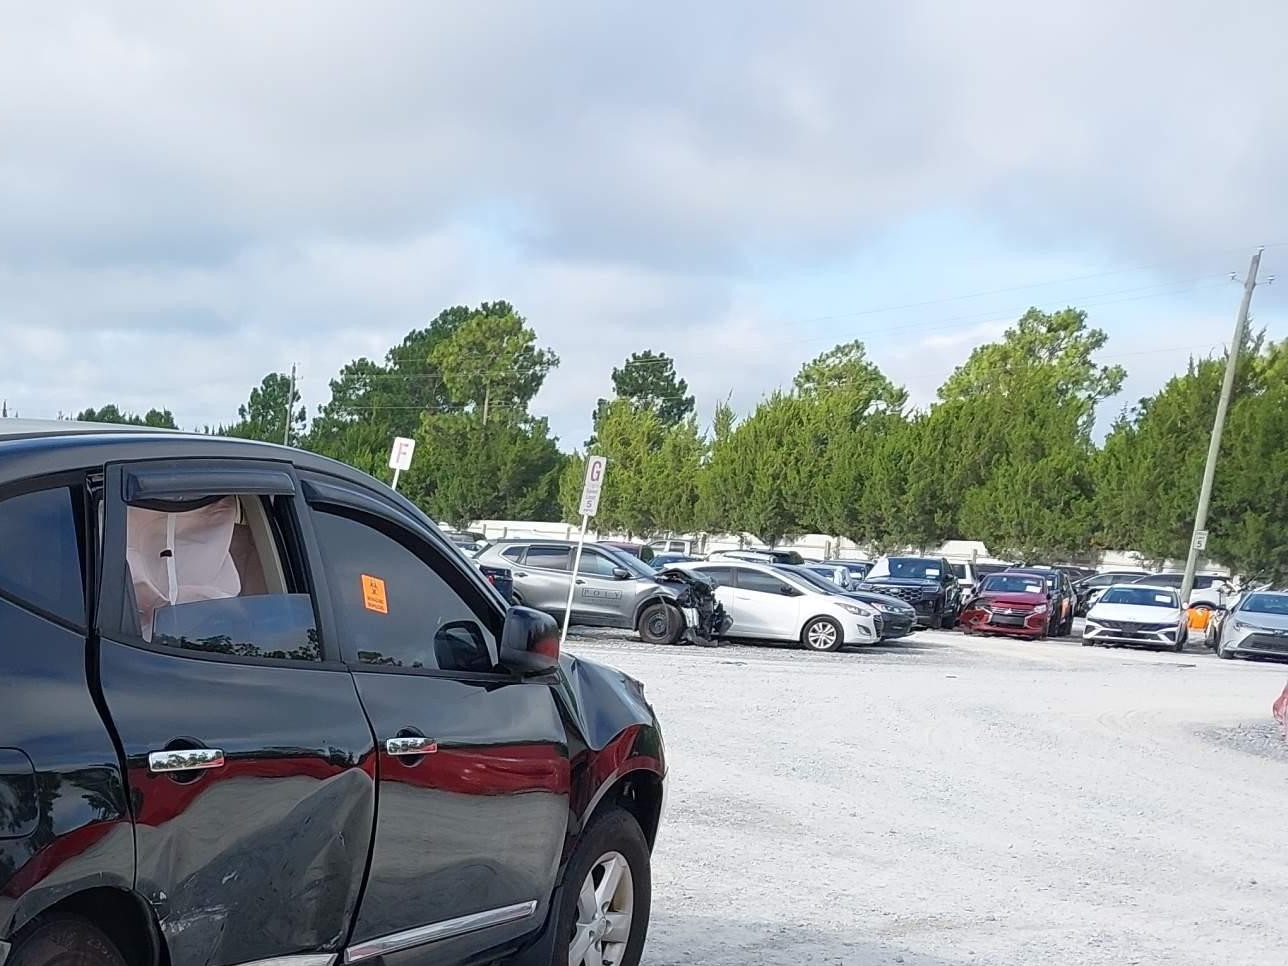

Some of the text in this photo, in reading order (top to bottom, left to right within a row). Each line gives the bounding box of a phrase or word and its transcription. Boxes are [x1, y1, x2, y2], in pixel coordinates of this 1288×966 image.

[396, 442, 409, 463] F
[590, 460, 602, 481] G
[586, 500, 593, 508] 5
